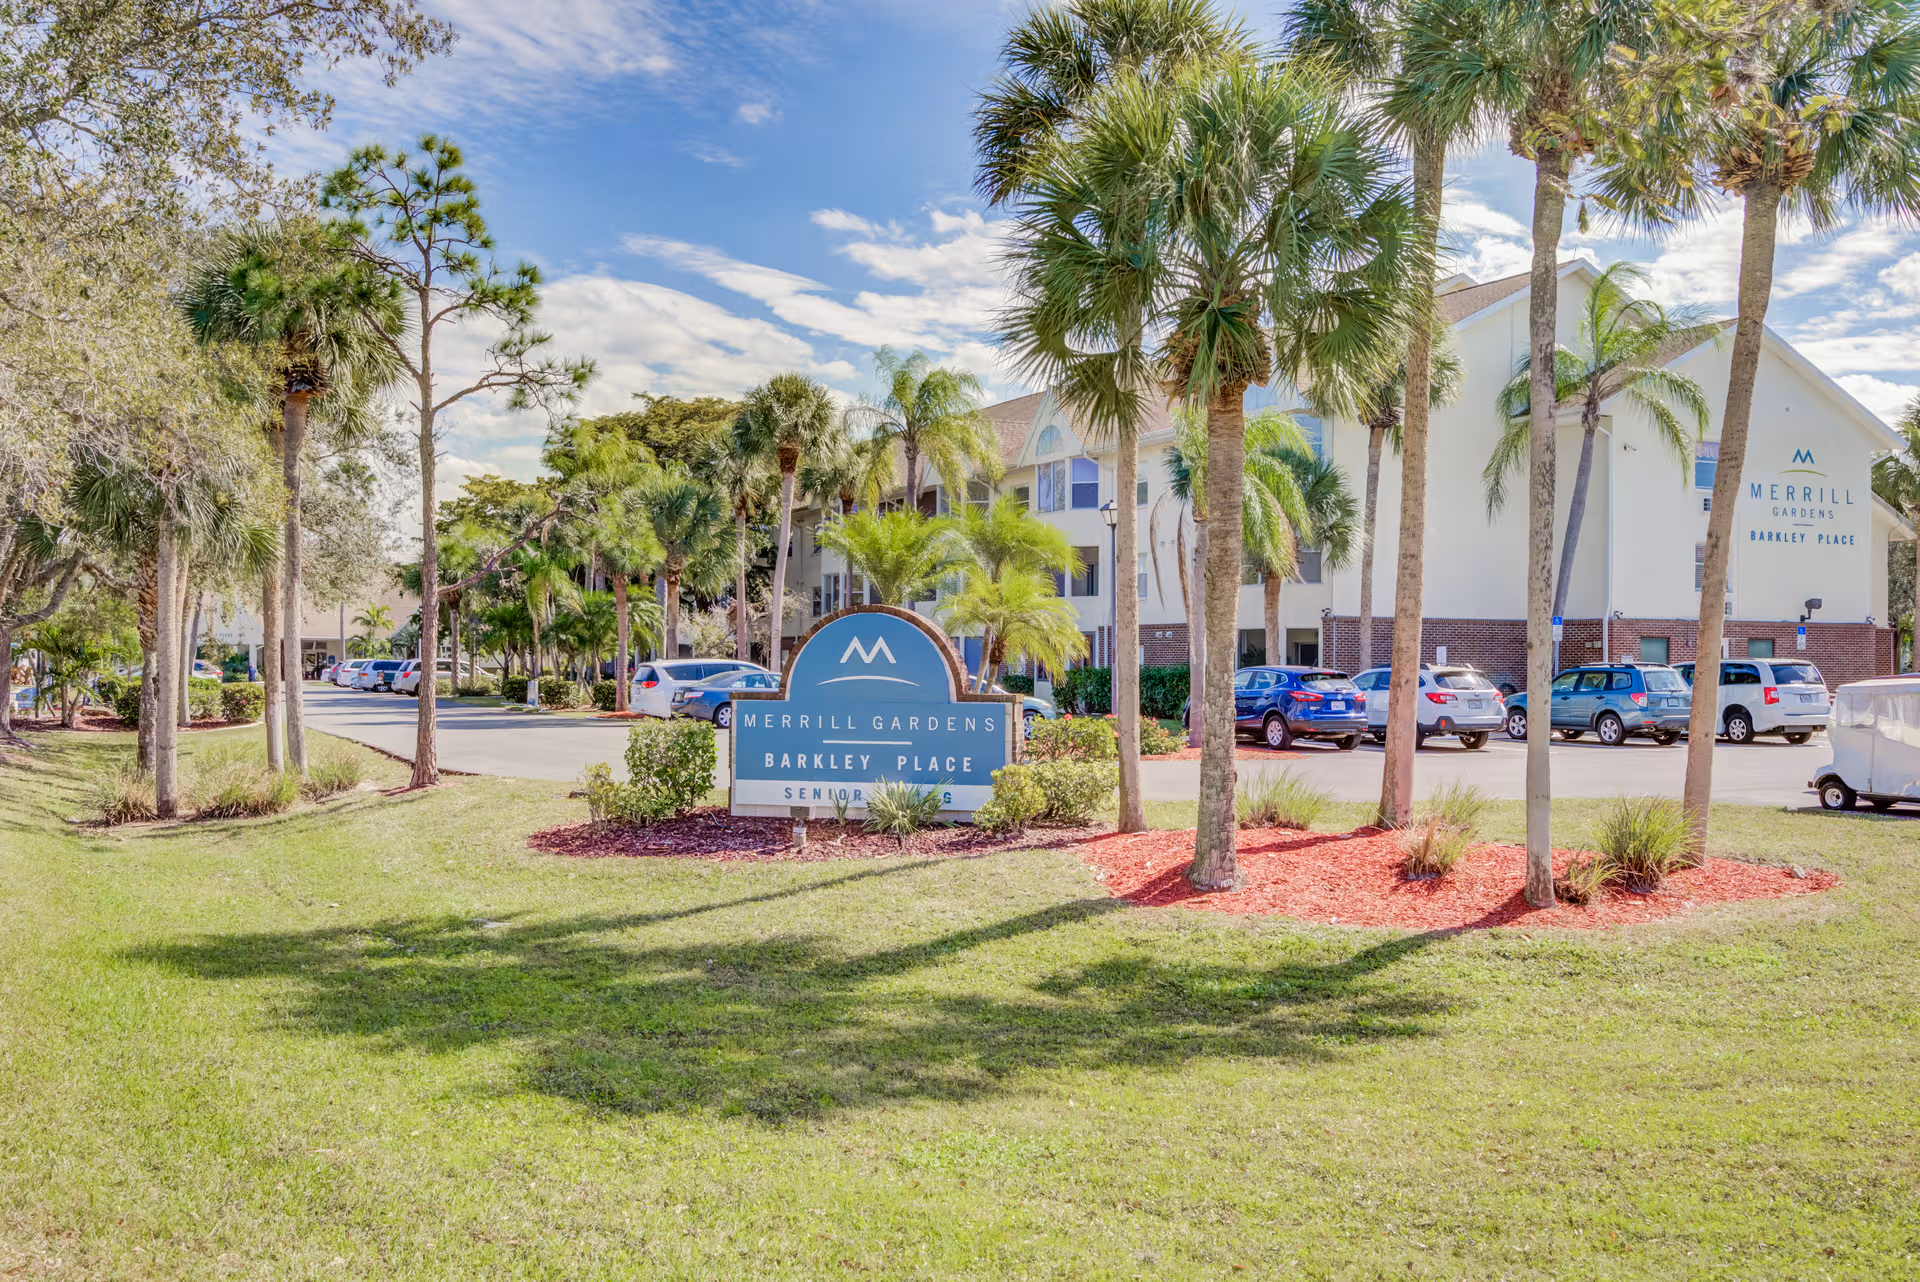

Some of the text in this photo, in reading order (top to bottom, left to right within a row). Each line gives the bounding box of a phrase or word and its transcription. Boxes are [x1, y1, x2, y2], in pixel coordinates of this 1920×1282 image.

[1750, 482, 1854, 505] MERRILL
[1772, 506, 1834, 520] GARDENS
[1750, 530, 1854, 546] BARKLEY PLACE
[744, 714, 995, 732] MERRILL GARDENS
[765, 752, 973, 773] BARKLEY PLACE
[784, 786, 862, 801] SENIOR
